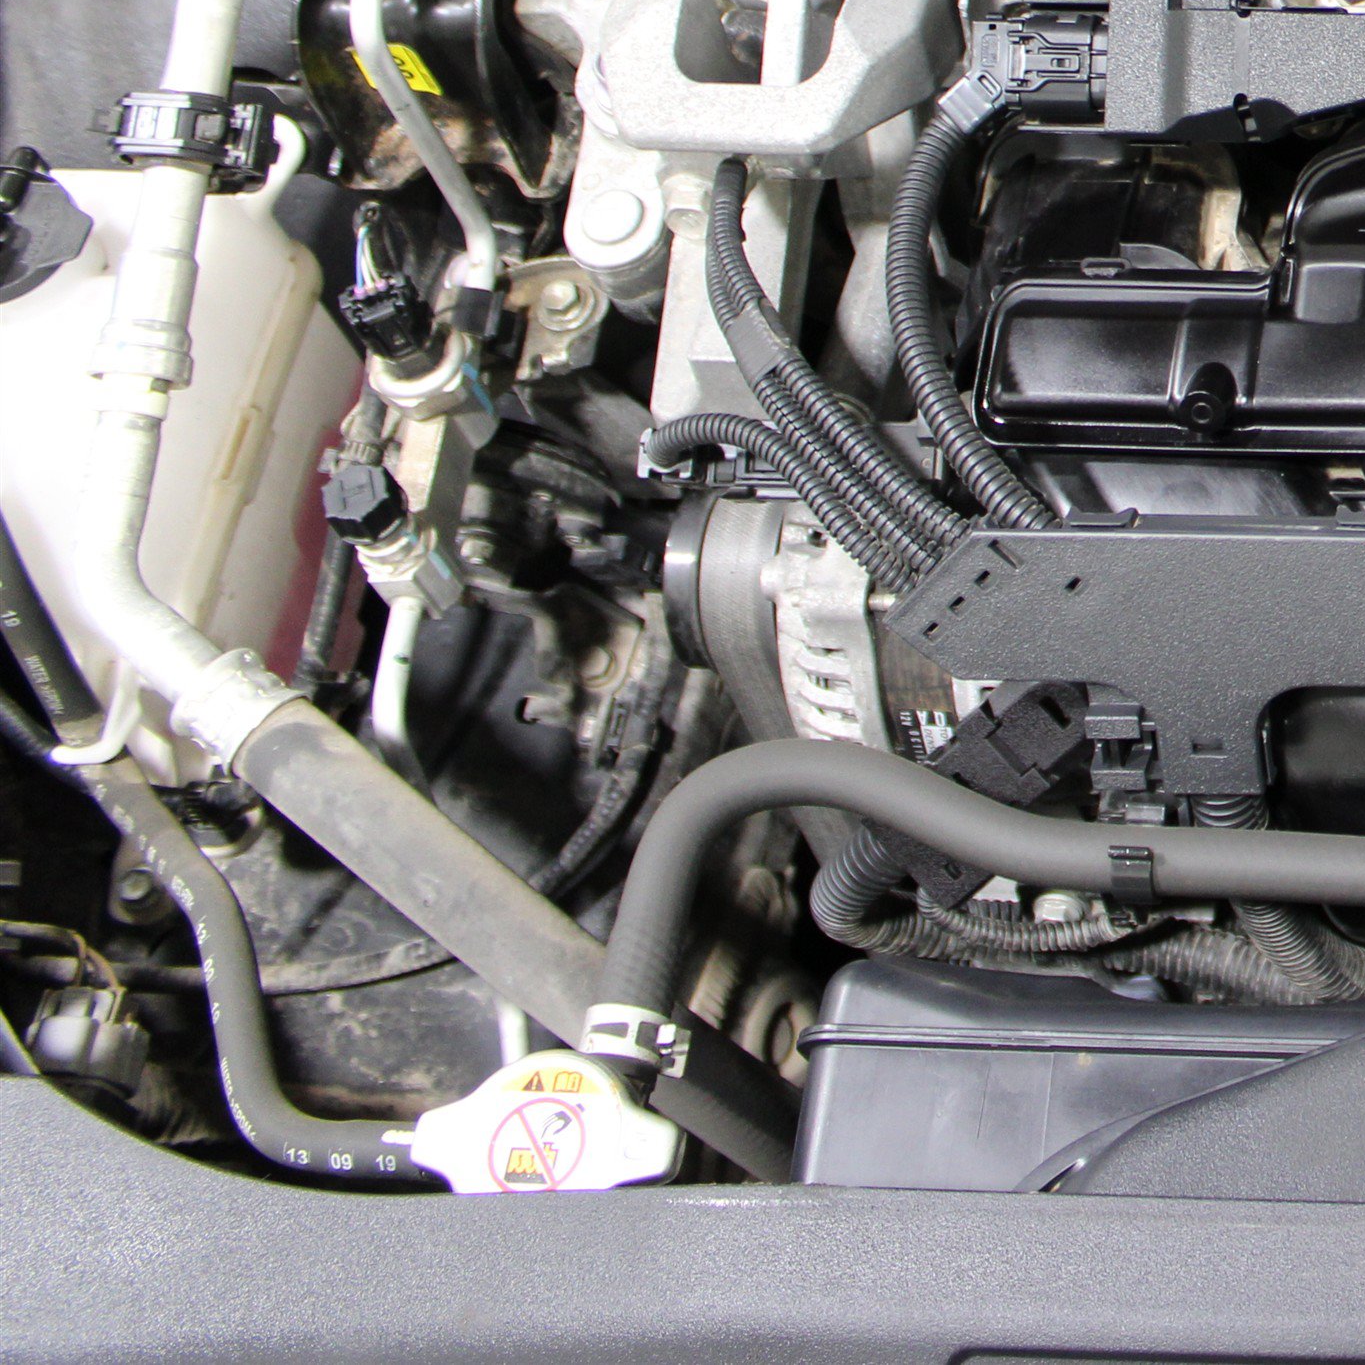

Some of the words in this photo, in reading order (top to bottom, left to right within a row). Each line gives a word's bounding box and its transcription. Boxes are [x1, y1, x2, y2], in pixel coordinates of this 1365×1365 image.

[286, 1147, 308, 1164] 13
[330, 1152, 352, 1170] 09
[375, 1154, 396, 1171] 19
